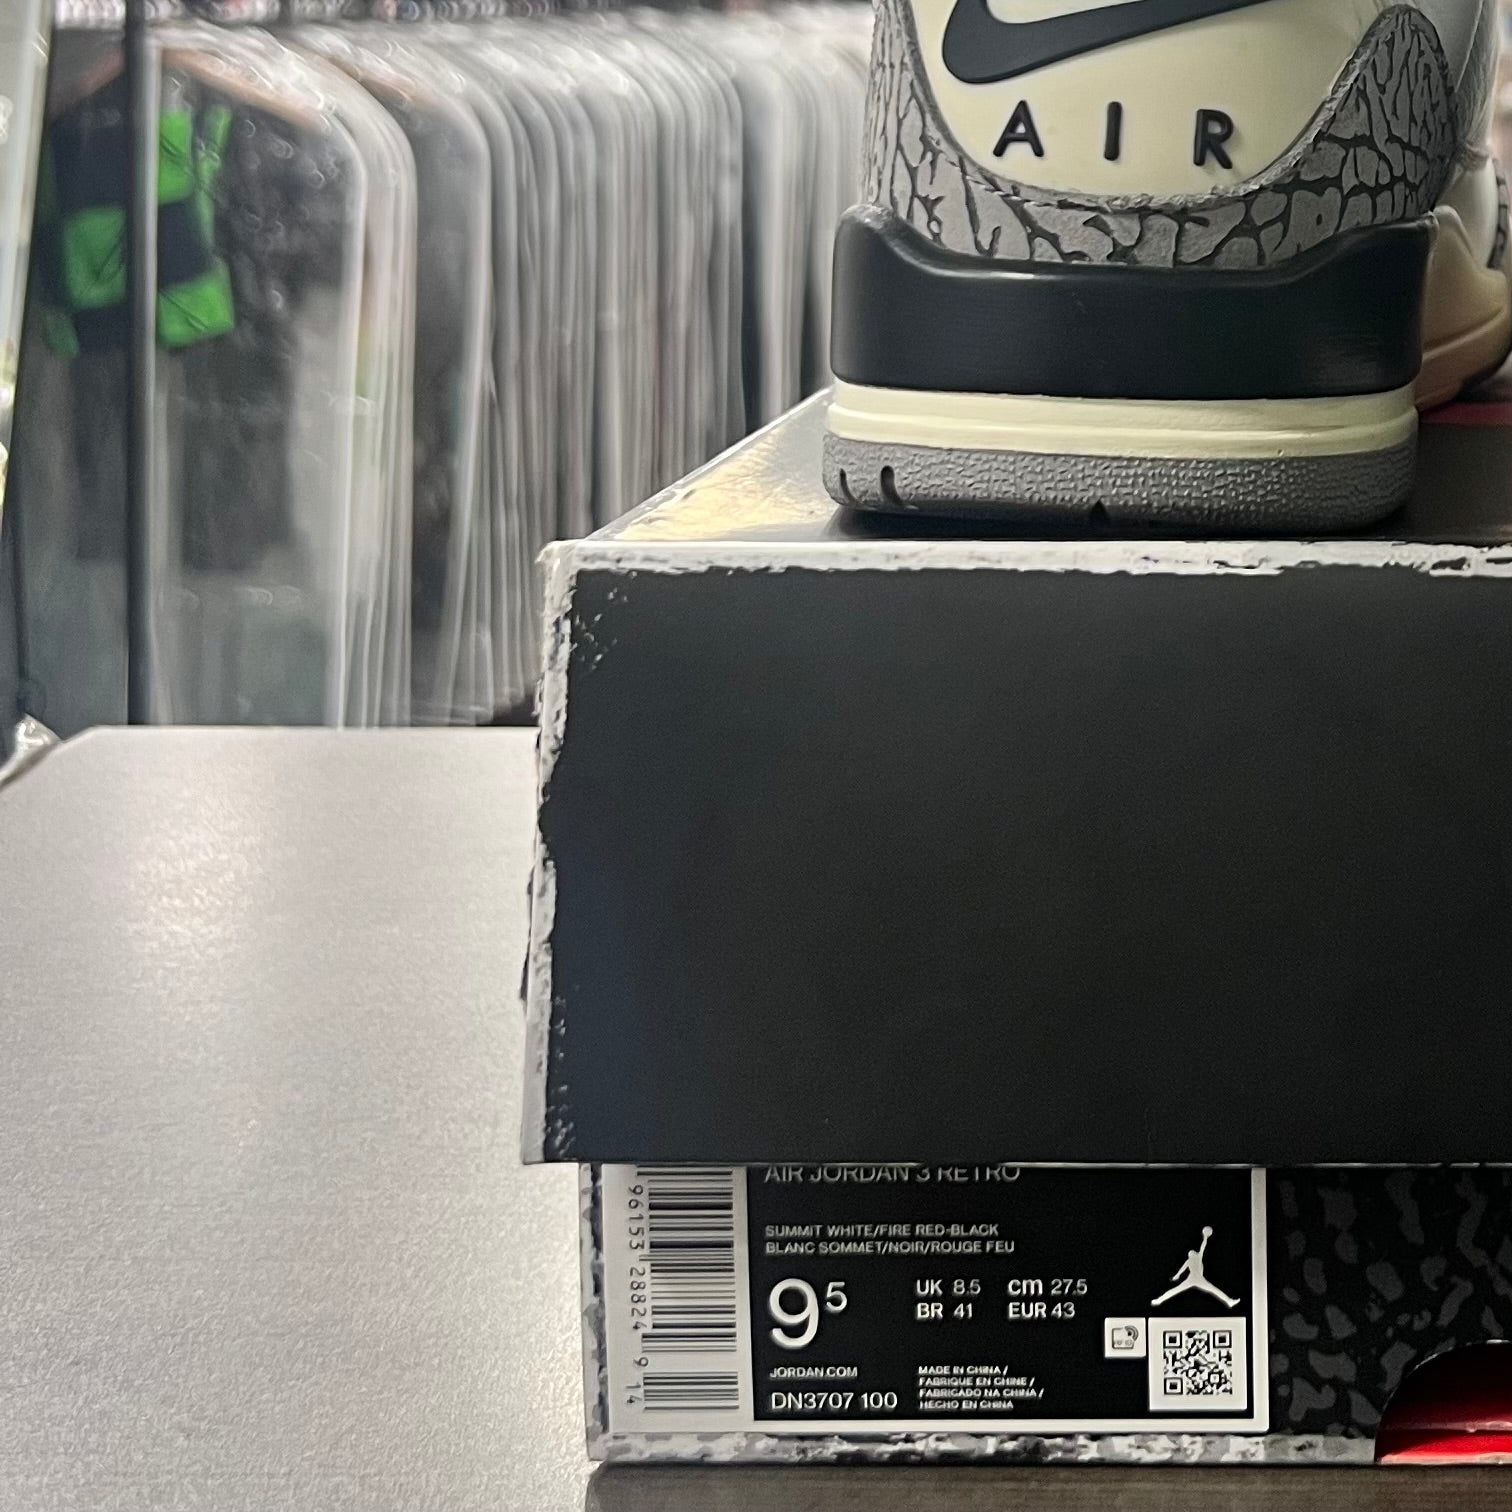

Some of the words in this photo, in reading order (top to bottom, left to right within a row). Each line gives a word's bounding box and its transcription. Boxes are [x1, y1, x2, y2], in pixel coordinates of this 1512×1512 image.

[993, 100, 1234, 170] AIR
[764, 1166, 803, 1183] AIR
[628, 1185, 645, 1250] 96153
[765, 1224, 823, 1238] SUMMIT
[827, 1223, 911, 1238] WHITE/FIRE
[915, 1223, 999, 1237] RED-BLACK
[765, 1241, 816, 1255] BLANC
[818, 1240, 982, 1255] SOMMET/NOIR/ROUGE
[985, 1240, 1015, 1253] FEU
[916, 1279, 943, 1296] UK
[953, 1279, 981, 1295] 8.5
[1007, 1279, 1043, 1296] cm
[1050, 1278, 1088, 1296] 27.5
[630, 1267, 647, 1330] 28824
[768, 1278, 819, 1349] 9
[826, 1281, 848, 1313] 5
[916, 1302, 944, 1320] BR
[953, 1302, 973, 1319] 41
[1008, 1301, 1047, 1319] EUR
[1051, 1301, 1076, 1319] 43
[769, 1366, 858, 1379] JORDAN.COM
[918, 1365, 951, 1375] MADE
[952, 1365, 964, 1375] IN
[966, 1365, 1001, 1375] CHINA
[919, 1376, 974, 1386] FABRIQUE
[975, 1376, 991, 1386] EN
[771, 1391, 855, 1411] DN3707
[860, 1391, 898, 1410] 100
[919, 1388, 982, 1398] FABRICADO
[983, 1388, 1001, 1398] NA
[1002, 1388, 1037, 1398] CHINA
[919, 1400, 960, 1409] HECHO
[961, 1400, 978, 1409] EN
[979, 1399, 1014, 1409] CHINA
